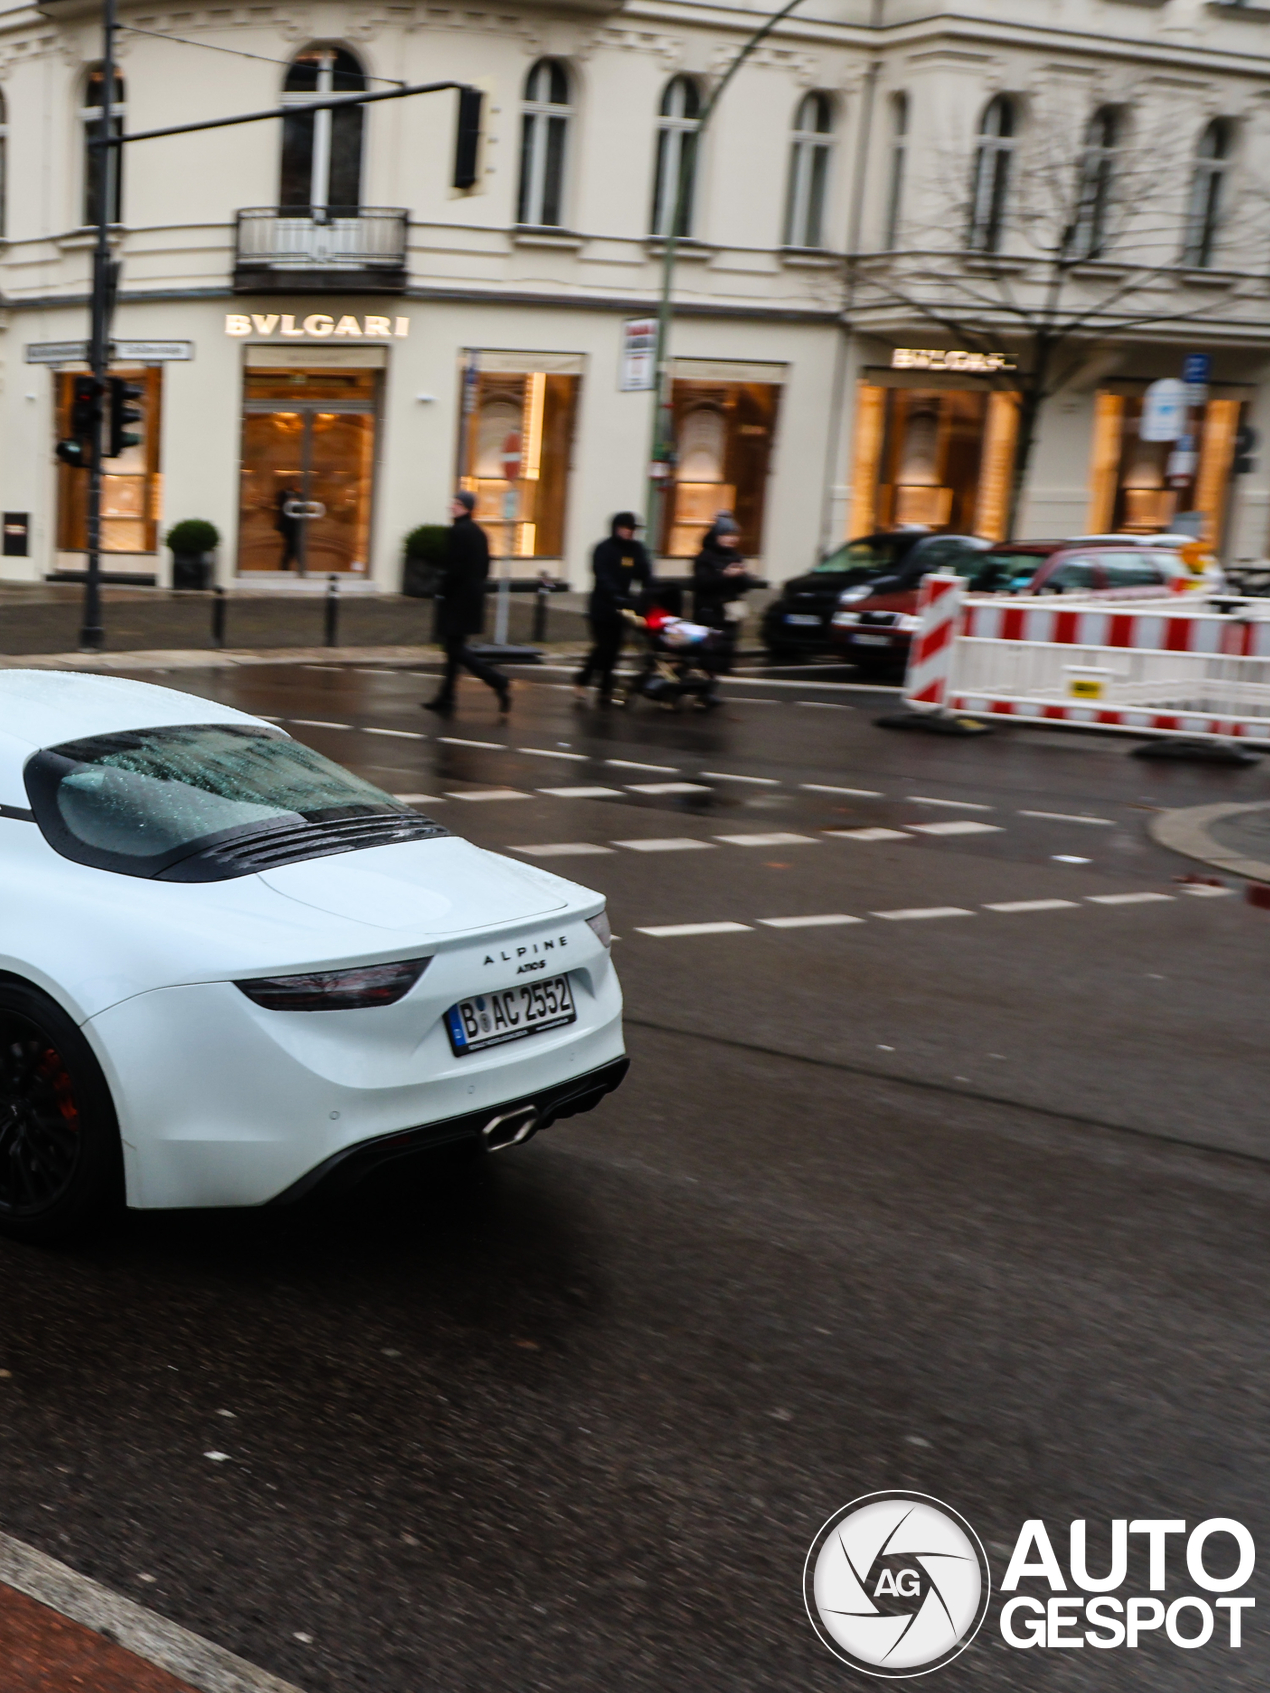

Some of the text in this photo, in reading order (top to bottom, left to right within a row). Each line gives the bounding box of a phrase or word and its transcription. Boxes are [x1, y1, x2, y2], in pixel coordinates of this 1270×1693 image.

[225, 314, 410, 338] BVLGARI
[483, 936, 567, 965] ALPINE
[460, 978, 570, 1038] B AC 2552
